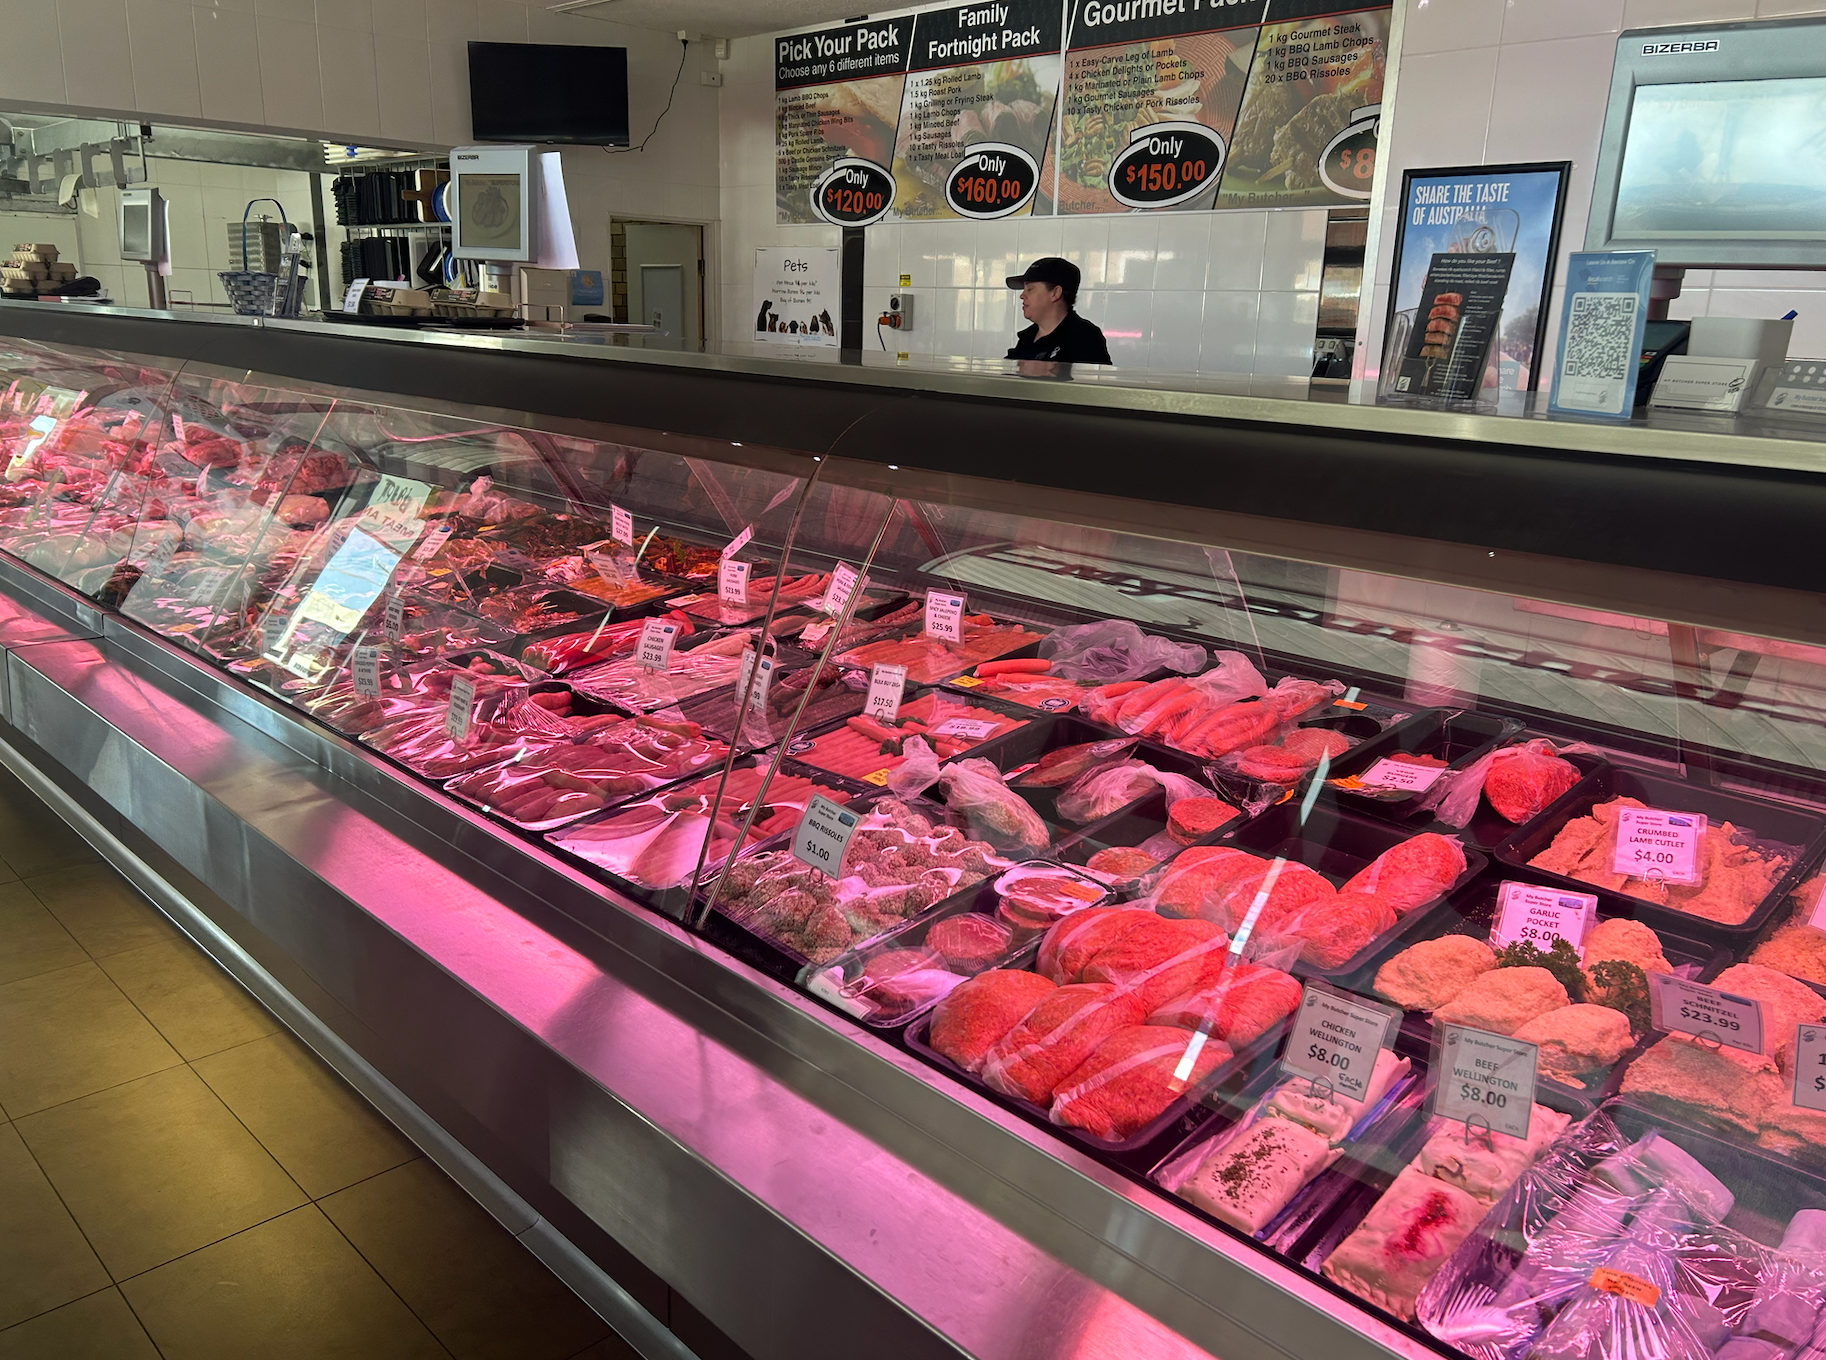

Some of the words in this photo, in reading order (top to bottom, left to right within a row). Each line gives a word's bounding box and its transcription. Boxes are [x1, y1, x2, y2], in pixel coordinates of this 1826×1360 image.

[958, 3, 1008, 28] Family
[1083, 0, 1185, 27] Gourmet
[929, 33, 997, 59] Fortnight
[1002, 26, 1040, 49] Pack
[1277, 34, 1288, 44] kg
[1290, 28, 1331, 41] Gourmet
[1334, 23, 1361, 35] Steak
[780, 39, 812, 63] Pick
[814, 35, 852, 57] Your
[857, 24, 898, 51] Pack
[1276, 47, 1286, 57] kg
[1289, 44, 1311, 54] BBQ
[1313, 41, 1339, 51] Lamb
[1342, 36, 1373, 48] Chops
[1643, 42, 1717, 54] BIZERBA
[779, 67, 809, 79] Choose
[812, 64, 827, 76] any
[829, 60, 835, 72] 6
[837, 56, 872, 71] different
[874, 53, 899, 66] items
[1082, 56, 1123, 67] Easy-Carve
[1126, 54, 1139, 62] Leg
[1142, 50, 1149, 59] of
[1152, 49, 1174, 58] Lamb
[1274, 60, 1284, 70] kg
[1288, 57, 1309, 68] BBQ
[1311, 52, 1358, 65] Sausages
[1081, 69, 1110, 79] Chicken
[1113, 64, 1143, 75] Delights
[1156, 59, 1187, 70] Pockets
[1265, 75, 1276, 84] 20
[1286, 70, 1307, 82] BBQ
[1310, 67, 1350, 79] Rissoles
[920, 78, 932, 86] 1.25
[943, 75, 962, 84] Rolled
[964, 73, 981, 81] Lamb
[1075, 84, 1083, 92] kg
[1085, 78, 1120, 90] Marinated
[1154, 74, 1175, 83] Lamb
[1179, 70, 1204, 80] Chops
[920, 90, 927, 98] kg
[929, 88, 946, 96] Roast
[924, 98, 944, 108] Grilling
[955, 96, 974, 105] Frying
[1074, 96, 1082, 104] kg
[1084, 91, 1116, 102] Gourmet
[1118, 88, 1155, 99] Sausages
[1083, 105, 1101, 115] Tasty
[1104, 101, 1133, 111] Chicken
[1146, 98, 1163, 107] Pork
[1166, 95, 1200, 106] Rissoles
[923, 131, 951, 140] Sausages
[922, 142, 937, 150] Tasty
[1149, 136, 1183, 158] Only
[919, 153, 933, 161] Tasty
[979, 155, 1006, 176] Only
[1339, 148, 1375, 179] $8
[846, 169, 868, 188] Only
[1126, 160, 1205, 192] $150.00
[958, 177, 1020, 204] $160.00
[1415, 185, 1450, 204] SHARE
[1453, 184, 1473, 203] THE
[1476, 183, 1510, 202] TASTE
[827, 188, 882, 214] $120.00
[1412, 207, 1426, 225] OF
[1427, 205, 1486, 225] AUSTRALIA
[784, 259, 808, 272] Pets
[725, 586, 740, 595] $23.99
[932, 622, 952, 632] $25.99
[644, 643, 663, 651] SAUSAGES
[642, 651, 661, 662] $23.99
[874, 696, 893, 707] $17.50
[1382, 775, 1414, 784] $2.50
[826, 807, 836, 815] Butcher
[808, 819, 820, 830] BBQ
[820, 826, 843, 843] RISSOLES
[1638, 828, 1678, 838] CRUMBED
[806, 840, 830, 861] $1.00
[1655, 840, 1685, 848] CUTLET
[1635, 849, 1674, 864] $4.00
[1530, 908, 1560, 919] GARLIC
[1526, 918, 1559, 928] POCKET
[1520, 926, 1560, 940] $8.00
[1683, 999, 1739, 1019] SCHNITZEL
[1697, 996, 1721, 1006] BEEF
[1331, 1005, 1350, 1016] Butcher
[1350, 1012, 1364, 1022] Super
[1365, 1018, 1378, 1027] Store
[1680, 1006, 1740, 1031] $23.99
[1321, 1020, 1356, 1038] CHICKEN
[1309, 1027, 1362, 1054] WELLINGTON
[1474, 1039, 1496, 1048] Butcher
[1496, 1044, 1512, 1052] Super
[1308, 1043, 1350, 1070] $8.00
[1475, 1058, 1499, 1071] BEEF
[1453, 1067, 1518, 1091] WELLINGTON
[1460, 1083, 1507, 1108] $8.00
[1505, 1123, 1519, 1131] EACH
